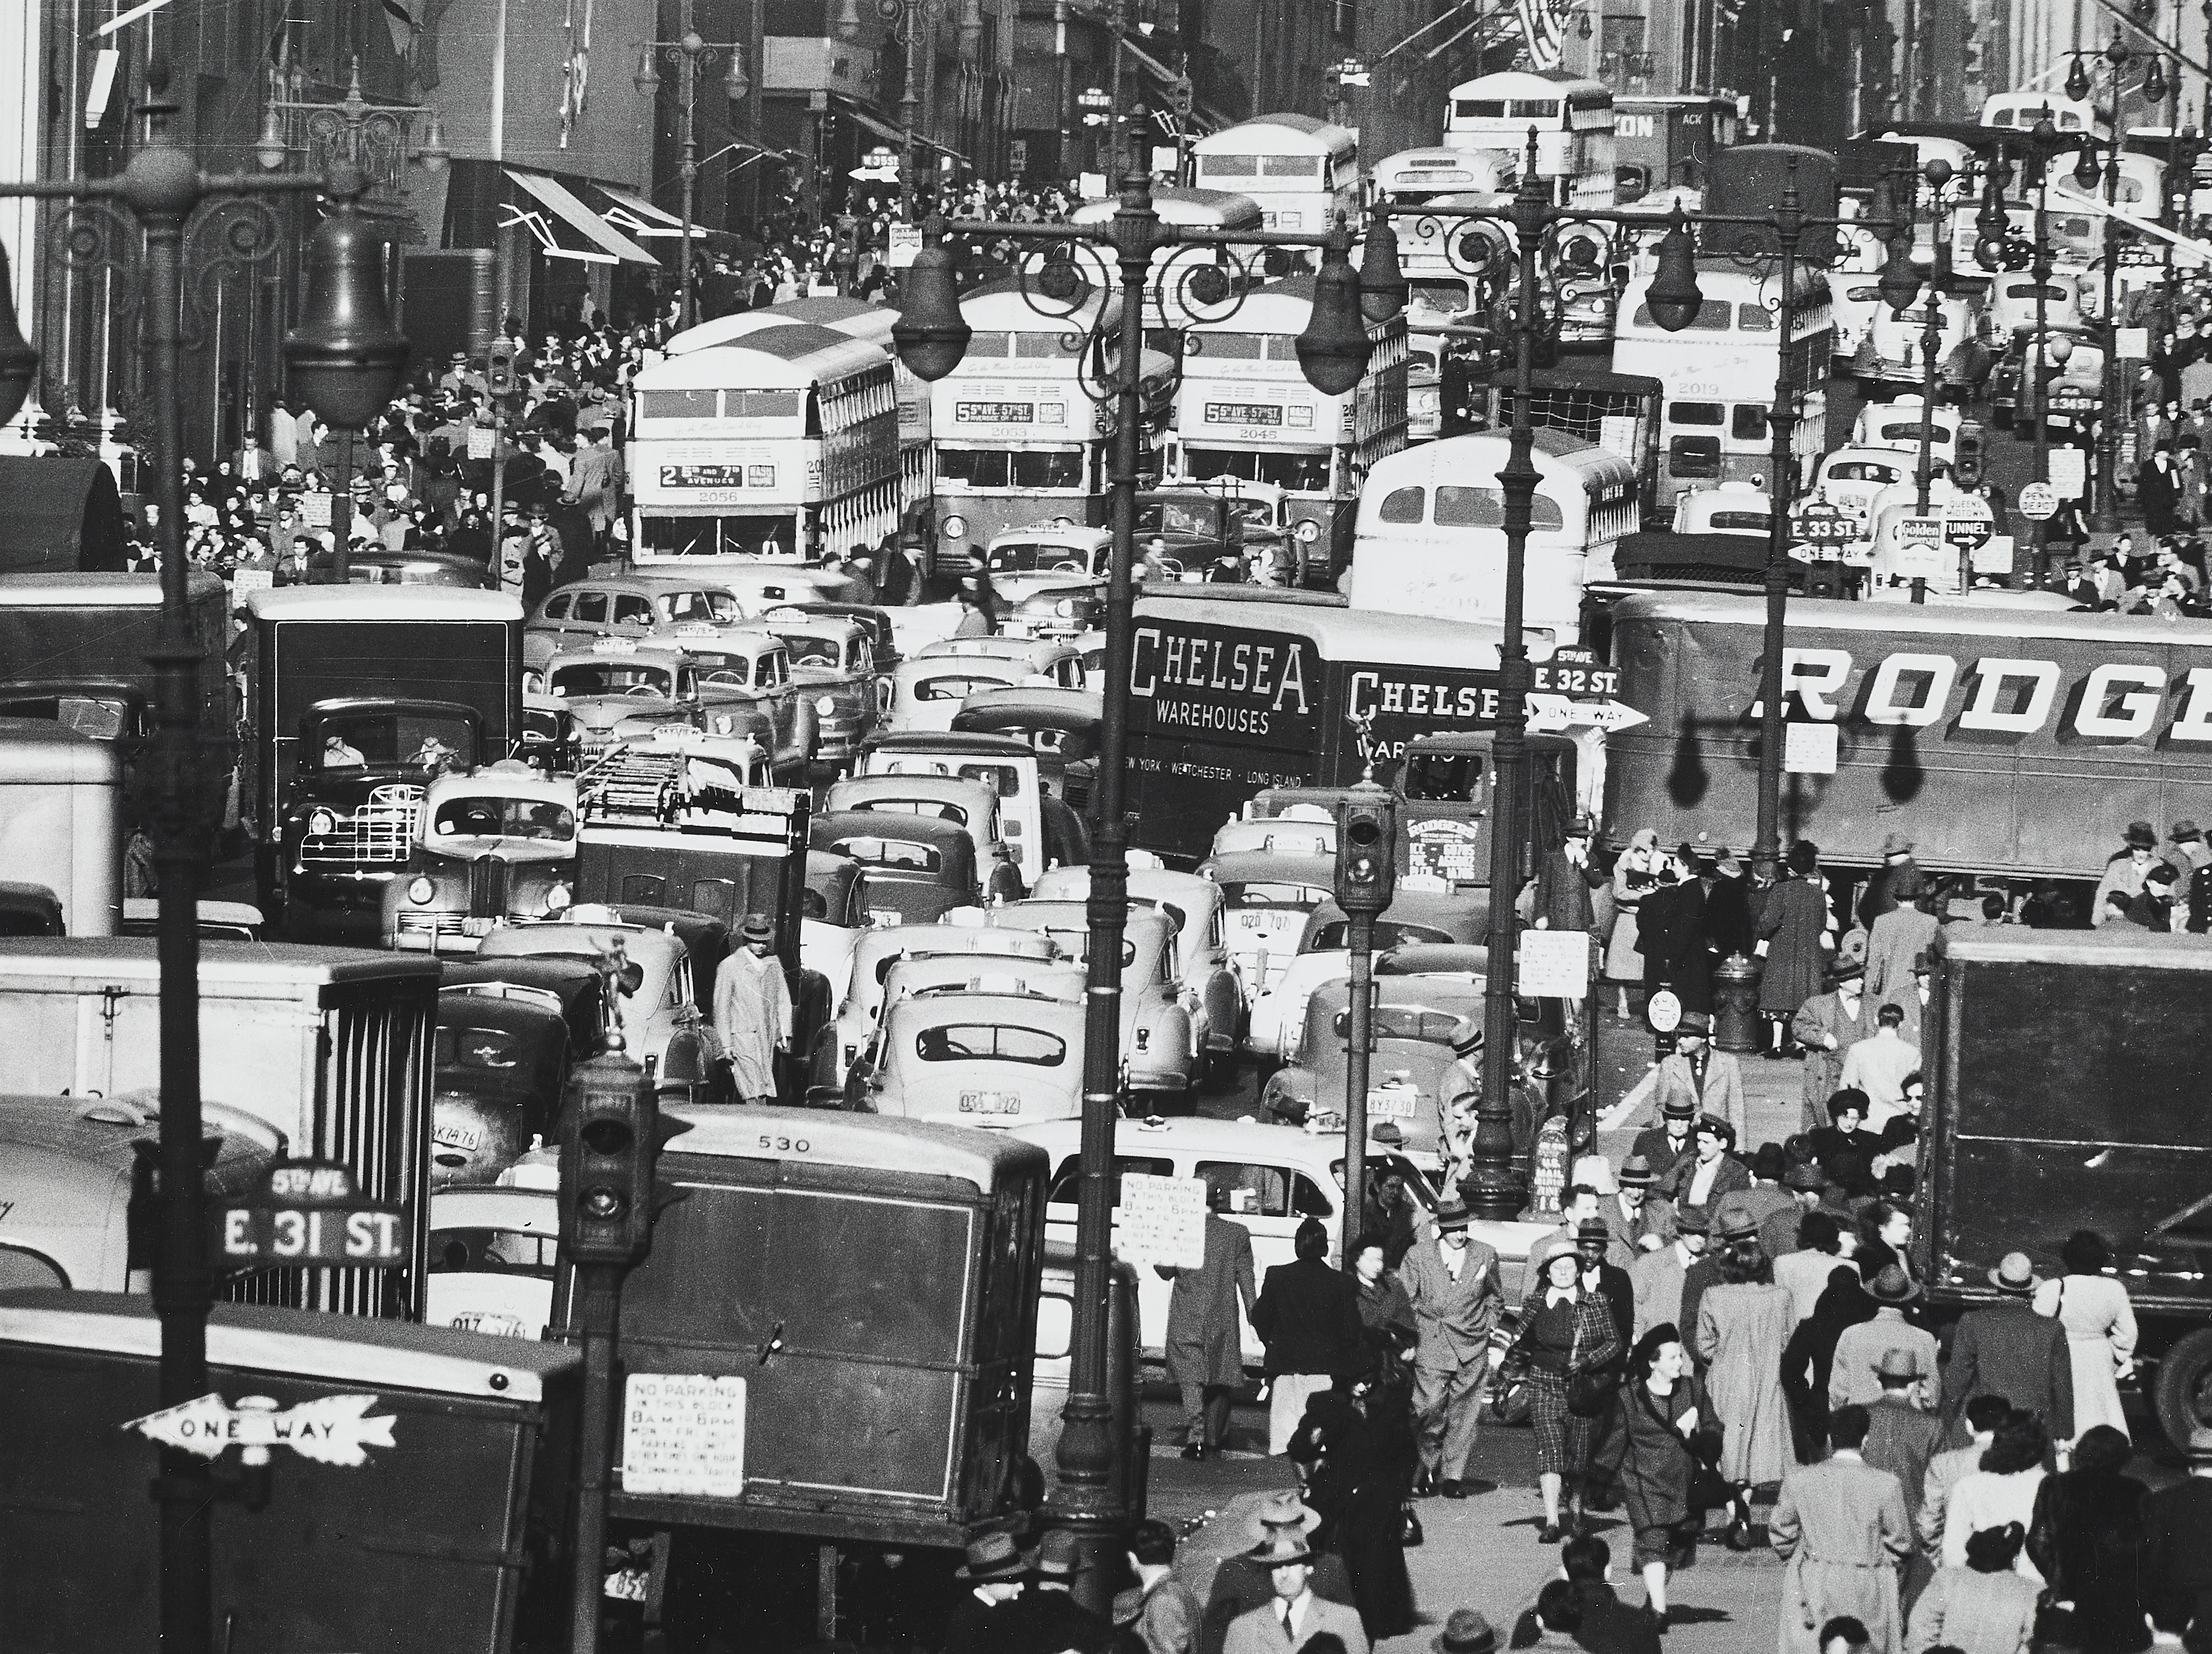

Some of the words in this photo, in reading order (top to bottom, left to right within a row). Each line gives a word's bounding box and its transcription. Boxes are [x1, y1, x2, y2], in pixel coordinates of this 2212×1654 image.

[1679, 382, 1719, 396] 2019
[958, 403, 970, 422] 5
[1207, 404, 1220, 422] 5
[1240, 429, 1278, 439] 2045
[662, 466, 677, 485] 2
[687, 477, 734, 485] AVENUES
[699, 492, 738, 503] 2056
[1950, 500, 1981, 510] QUEENS
[1809, 521, 1831, 537] 33
[1902, 522, 1939, 536] Golden
[1575, 650, 1593, 663] AVE
[1130, 627, 1309, 715] CHELSEA
[1534, 667, 1551, 689] E.
[1557, 669, 1586, 692] 32
[1590, 671, 1618, 694] ST.
[1349, 671, 1499, 722] CHELSE
[1156, 698, 1269, 735] WAREHOUSES
[1139, 758, 1161, 772] YORK
[1247, 771, 1269, 785] LONG
[1272, 774, 1301, 788] ISLAND
[1407, 820, 1478, 839] RODGERS
[1653, 995, 1676, 1007] BUS
[1651, 1012, 1677, 1026] STOP
[759, 1136, 810, 1153] 530
[1127, 1181, 1143, 1190] NO
[1148, 1181, 1200, 1195] PARKING
[224, 1209, 258, 1254] E.
[274, 1210, 321, 1257] 31
[346, 1211, 403, 1257] ST.
[634, 1383, 657, 1396] NO
[665, 1383, 737, 1398] PARKING
[181, 1419, 240, 1439] ONE
[273, 1420, 335, 1439] WAY
